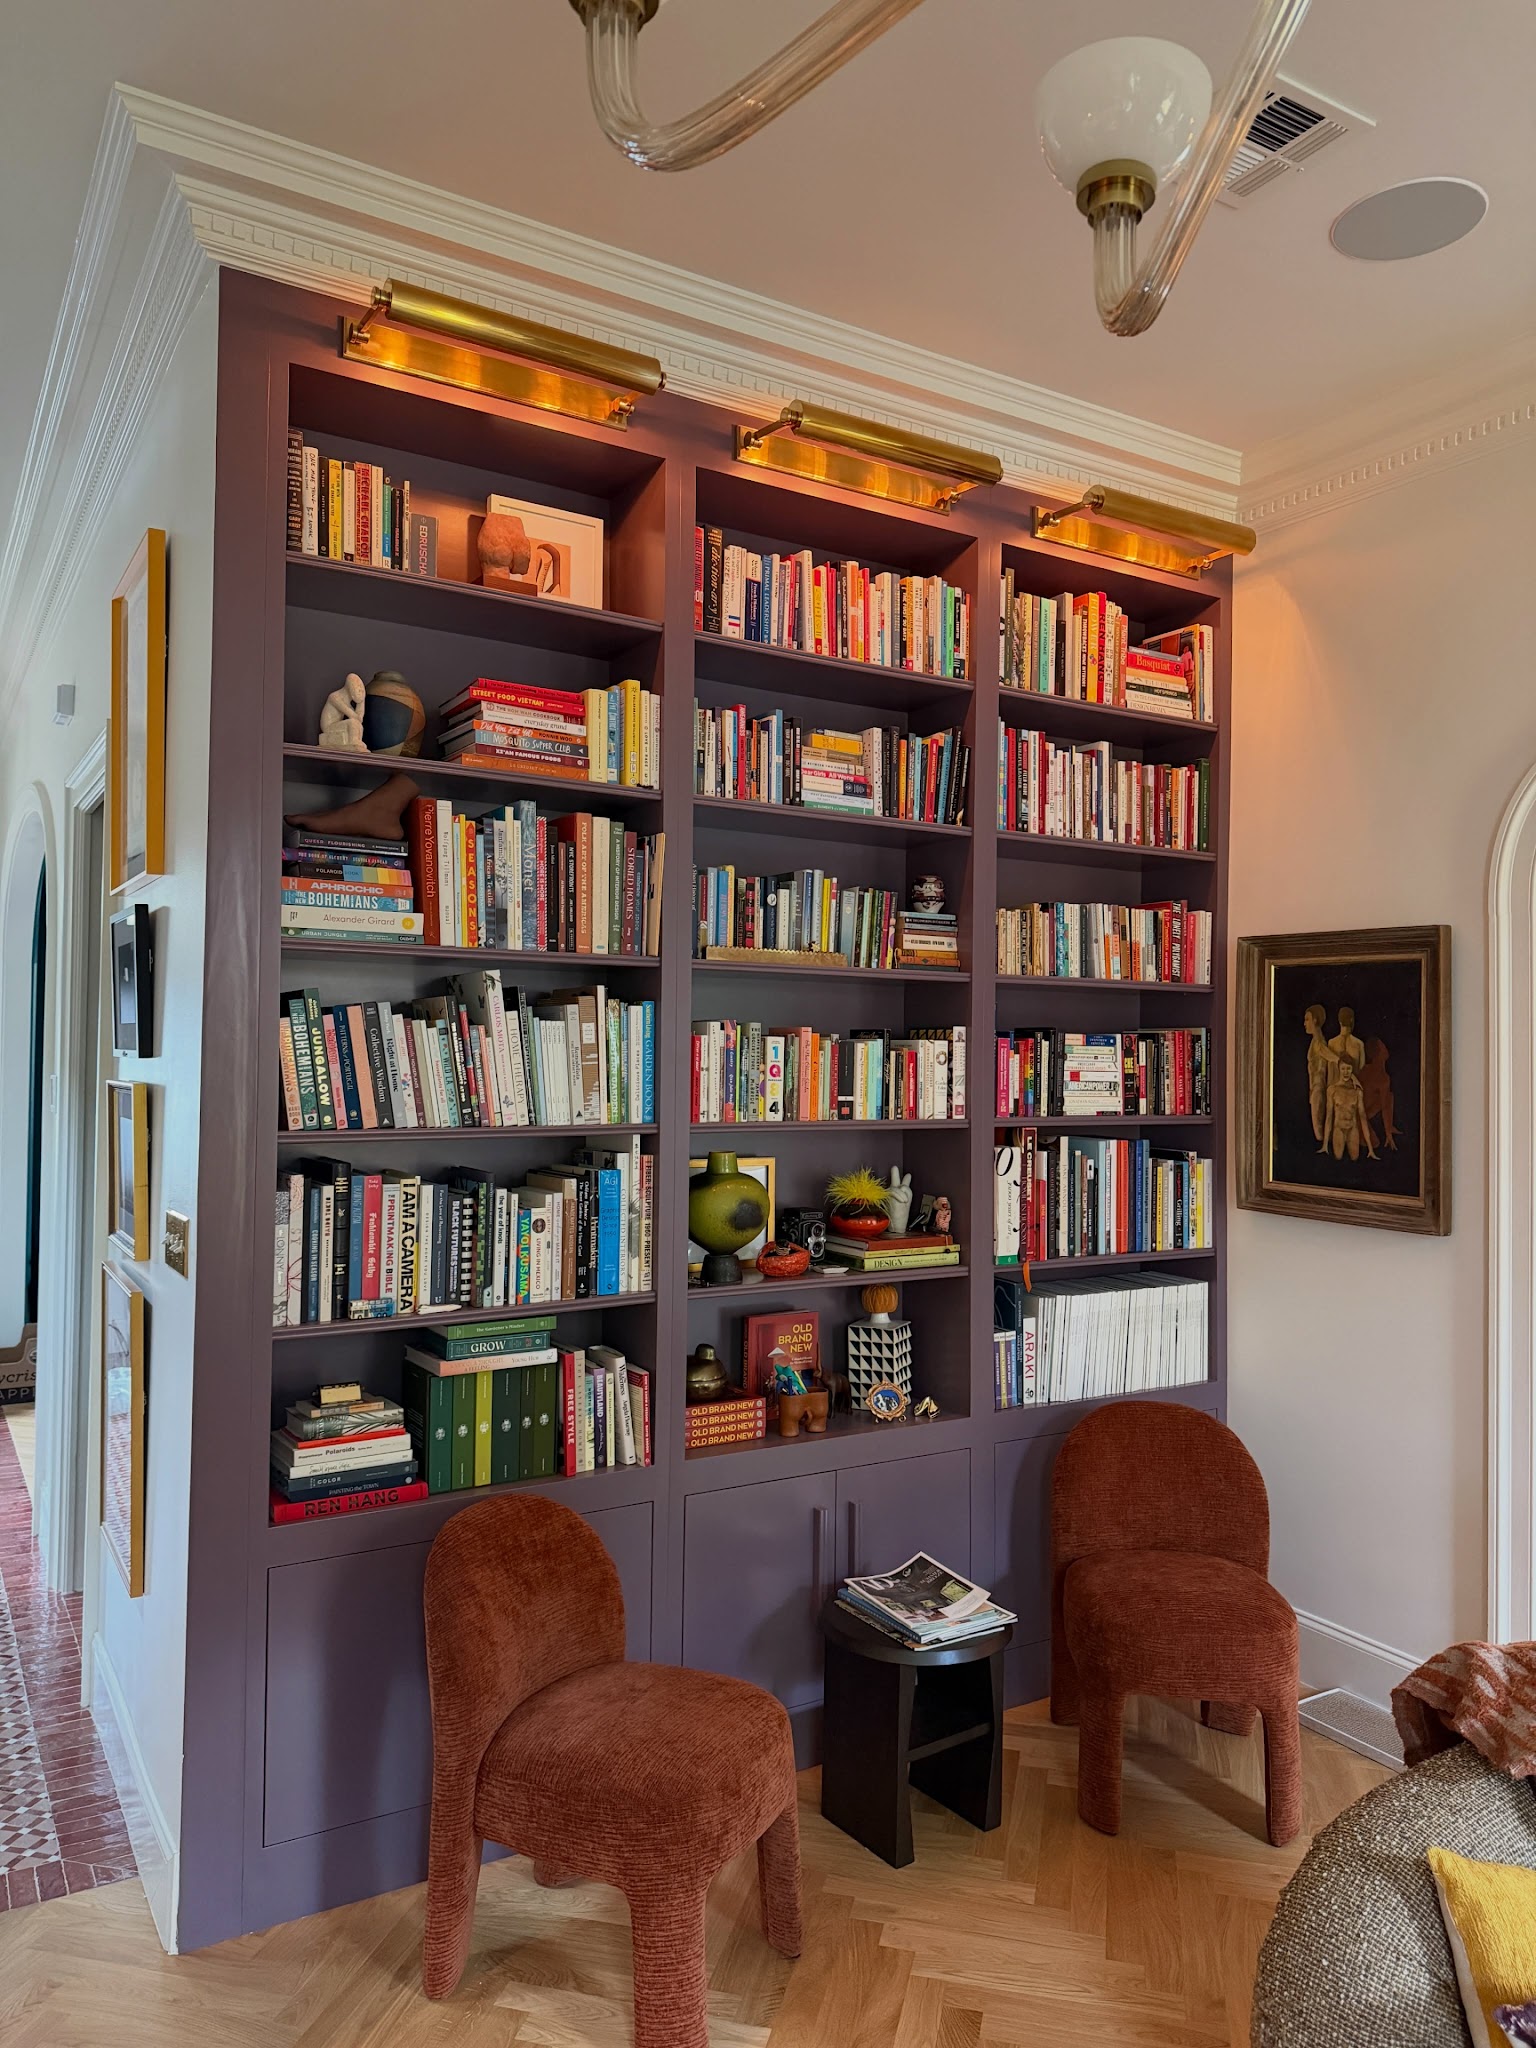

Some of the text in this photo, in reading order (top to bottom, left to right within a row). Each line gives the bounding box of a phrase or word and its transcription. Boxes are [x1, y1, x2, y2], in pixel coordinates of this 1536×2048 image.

[360, 468, 369, 558] MICHAEL CHABON
[1136, 655, 1170, 671] Basquiat
[472, 689, 496, 698] STREET
[497, 694, 516, 702] FOOD
[517, 697, 544, 707] VIETNAM
[424, 804, 436, 898] Pierre Yovanovitch
[523, 842, 536, 892] Monet
[581, 862, 587, 872] OF
[310, 882, 384, 894] APHROCHIC
[308, 892, 378, 909] BOHEMIANS
[626, 887, 634, 920] HOMES
[323, 914, 395, 925] Alexander Girard
[1172, 903, 1181, 977] THE LONELY POLYGAMIST
[493, 996, 505, 1053] CARLOS MOTA
[293, 1025, 315, 1094] BOHEMIANS
[312, 1027, 330, 1106] JUNGALOW
[369, 1028, 386, 1103] Collective Wisdom
[386, 1038, 399, 1092] Right at Home
[510, 1028, 525, 1105] HOME THERAPY
[1027, 1136, 1032, 1151] LE
[402, 1191, 416, 1219] AM
[386, 1199, 395, 1266] PRINTMAKING
[401, 1222, 414, 1234] A
[450, 1201, 460, 1266] BLACK FUTURES
[520, 1218, 530, 1297] YAYOI KUSAMA
[874, 1258, 904, 1269] DESIGN
[400, 1236, 414, 1311] CAMERA
[792, 1323, 812, 1333] OLD
[470, 1340, 507, 1353] GROW
[778, 1334, 812, 1344] BRAND
[790, 1343, 812, 1353] NEW
[1025, 1331, 1034, 1378] ARAKI
[692, 1401, 755, 1416] OLD BRAND NEW
[692, 1411, 755, 1427] OLD BRAND NEW
[692, 1422, 755, 1437] OLD BRAND NEW
[690, 1432, 754, 1447] OLD BRAND NEW
[325, 1447, 355, 1455] Polaroids
[317, 1477, 341, 1485] COLOR
[305, 1490, 399, 1516] REN HANG
